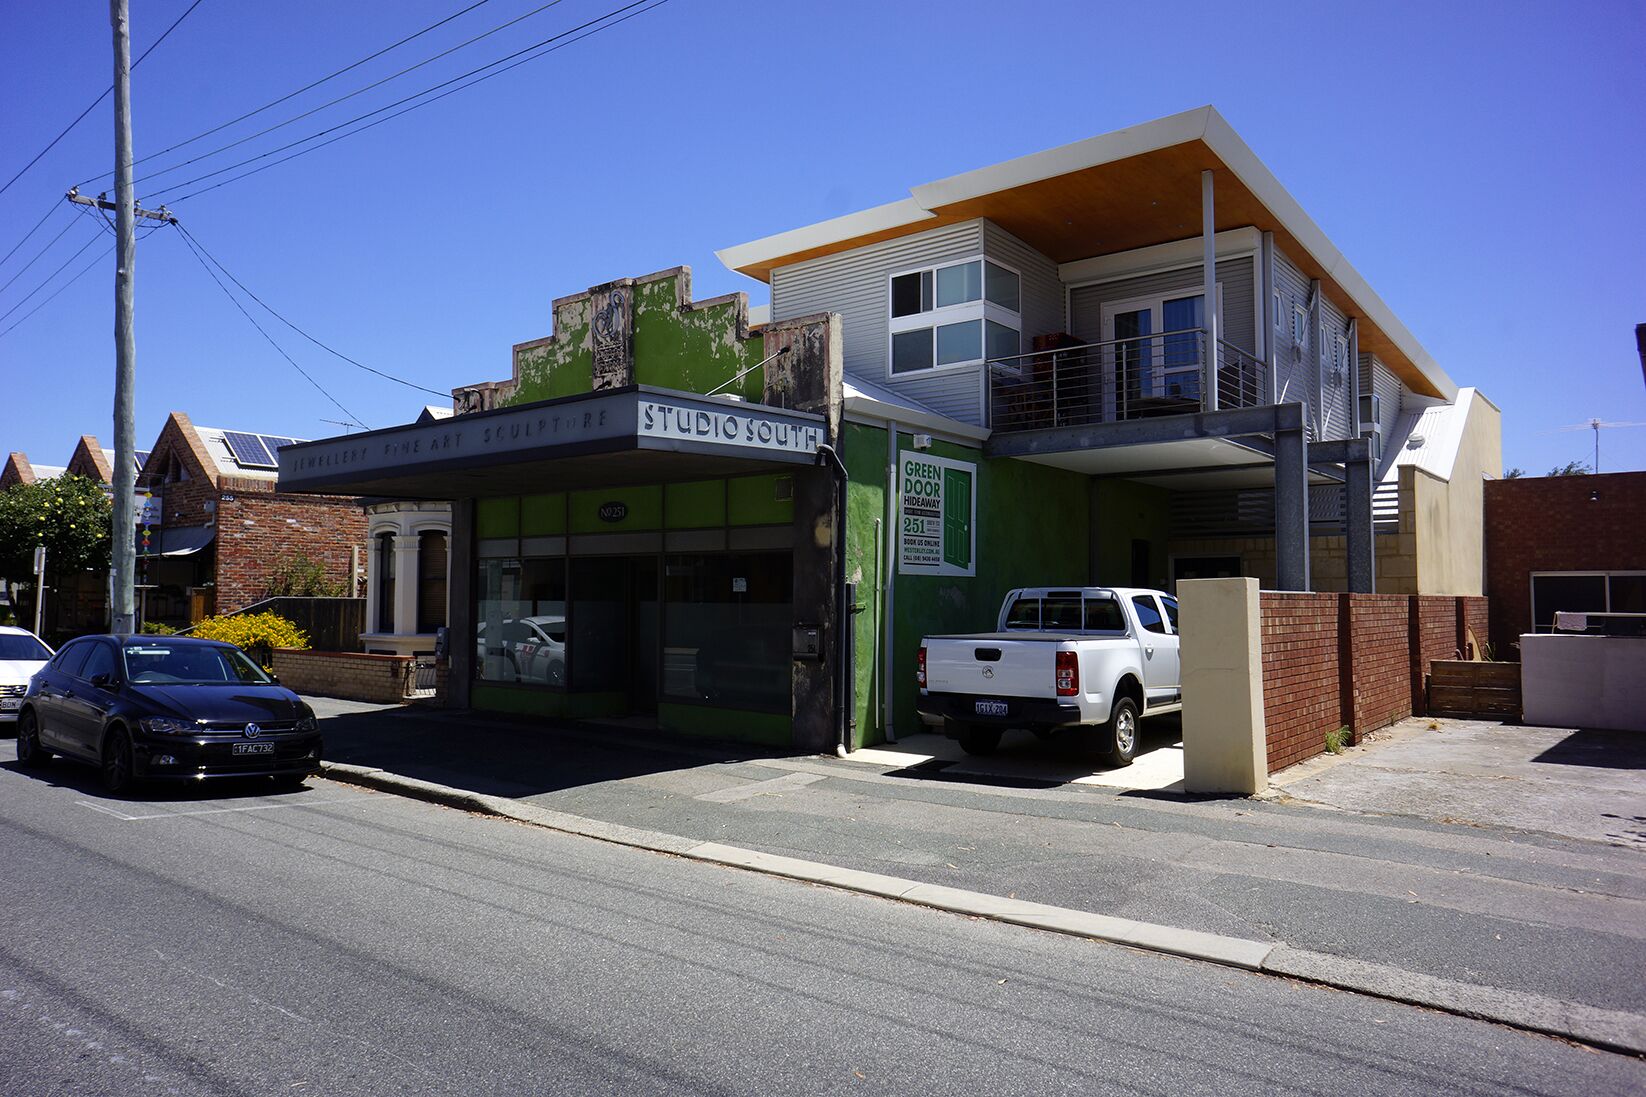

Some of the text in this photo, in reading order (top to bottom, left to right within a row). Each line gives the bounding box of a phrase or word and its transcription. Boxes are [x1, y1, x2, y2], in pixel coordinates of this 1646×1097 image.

[644, 404, 817, 450] STUDIO SOUTH
[293, 410, 606, 472] JEWELLERY FINE ART SCULPTURE
[905, 460, 941, 481] GREEN
[905, 477, 941, 498] DOOR
[904, 495, 941, 509] HIDEAWAY
[904, 517, 926, 534] 251
[904, 538, 917, 546] BOOK
[924, 539, 940, 548] ONLINE
